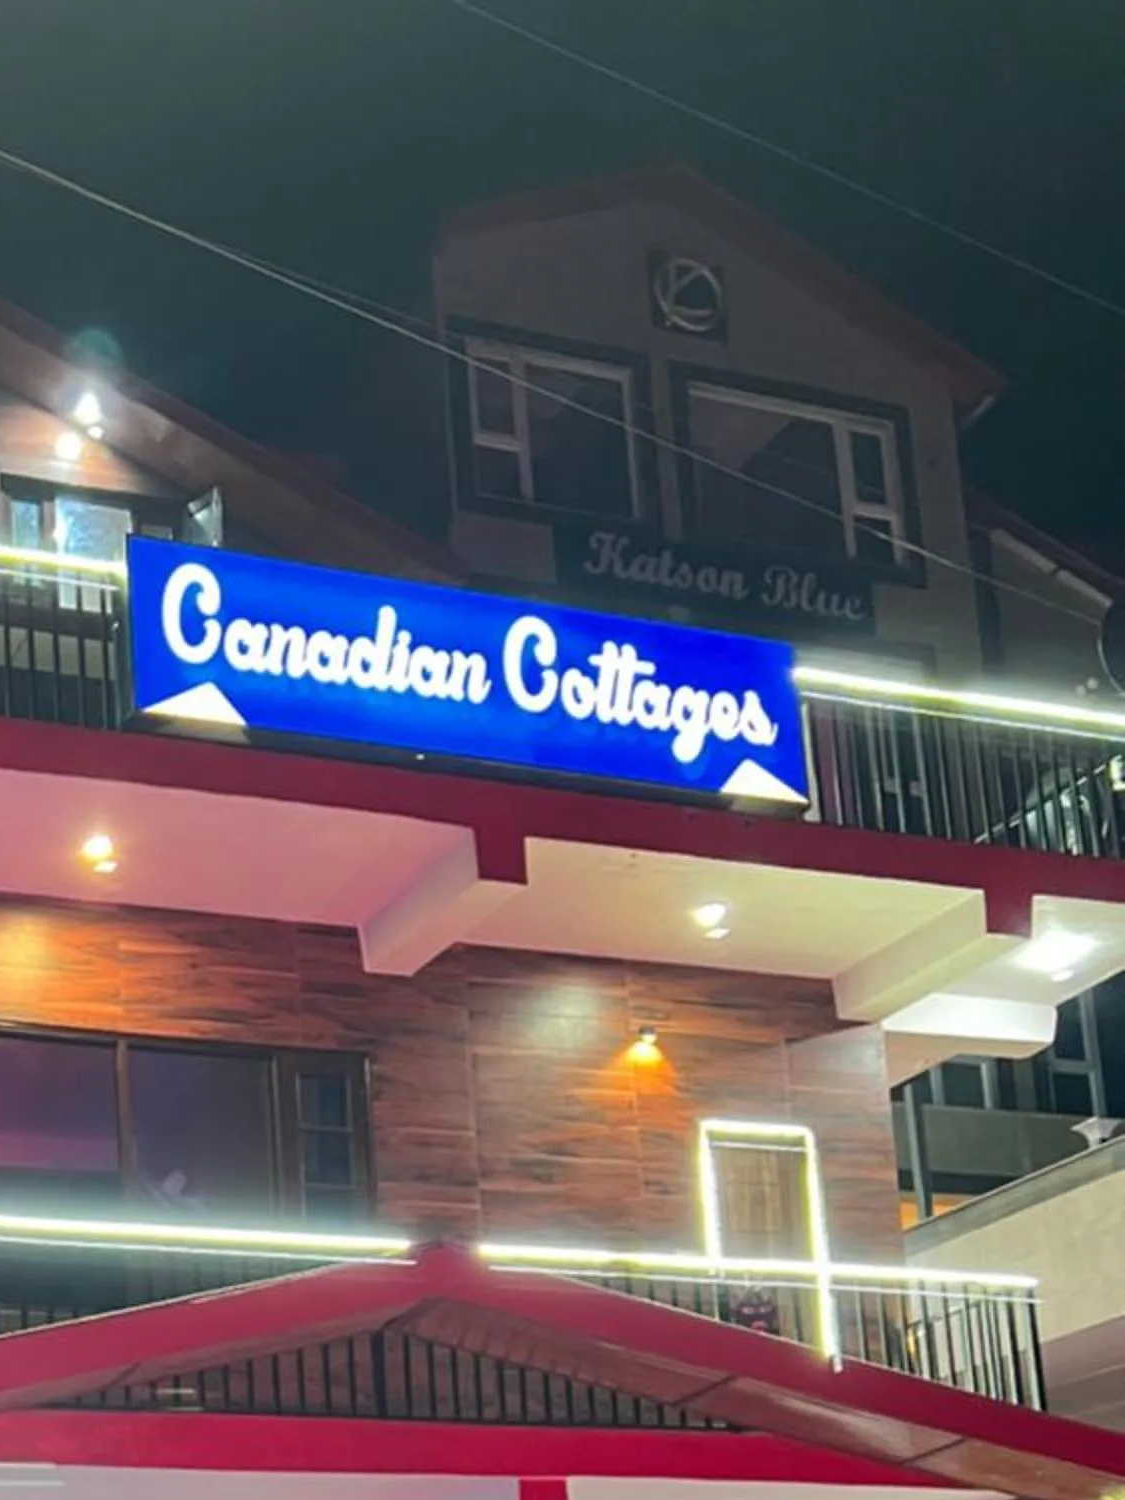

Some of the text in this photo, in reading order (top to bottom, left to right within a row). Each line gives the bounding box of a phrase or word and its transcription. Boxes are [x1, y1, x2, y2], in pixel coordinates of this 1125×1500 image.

[584, 531, 864, 620] Katson Blue
[161, 562, 778, 763] Canadian Cottages
